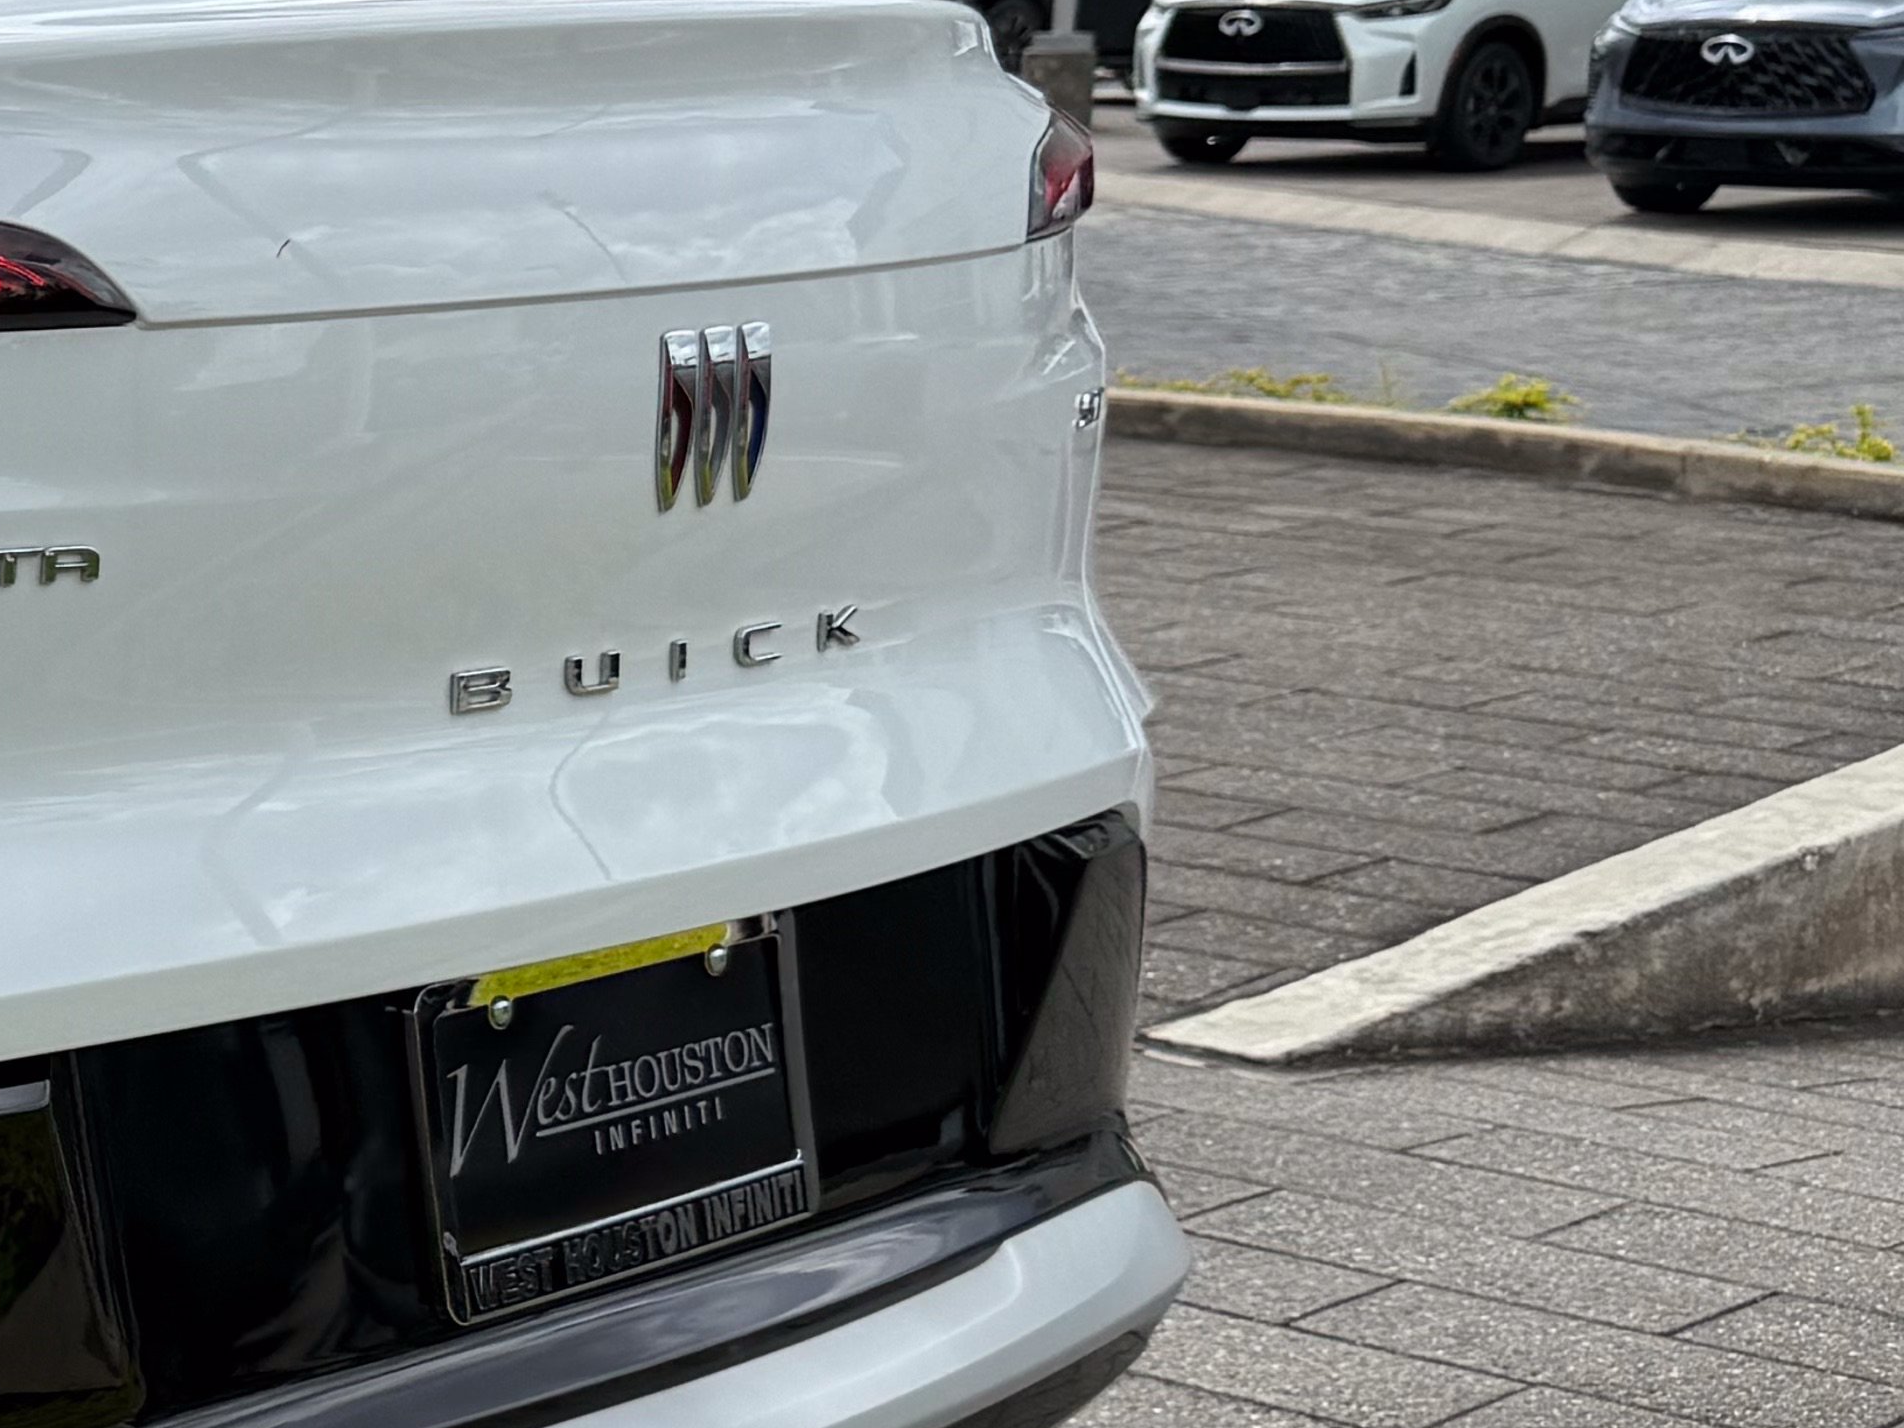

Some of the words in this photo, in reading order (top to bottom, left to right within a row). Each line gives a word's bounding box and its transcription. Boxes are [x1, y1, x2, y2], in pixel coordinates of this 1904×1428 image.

[449, 603, 861, 715] BUICK
[445, 1023, 610, 1179] West
[607, 1021, 775, 1108] HOUSTON
[593, 1095, 725, 1156] INFINITI
[469, 1252, 555, 1311] WEST
[563, 1202, 699, 1286] HOUSTON
[703, 1167, 806, 1241] INFINITI
